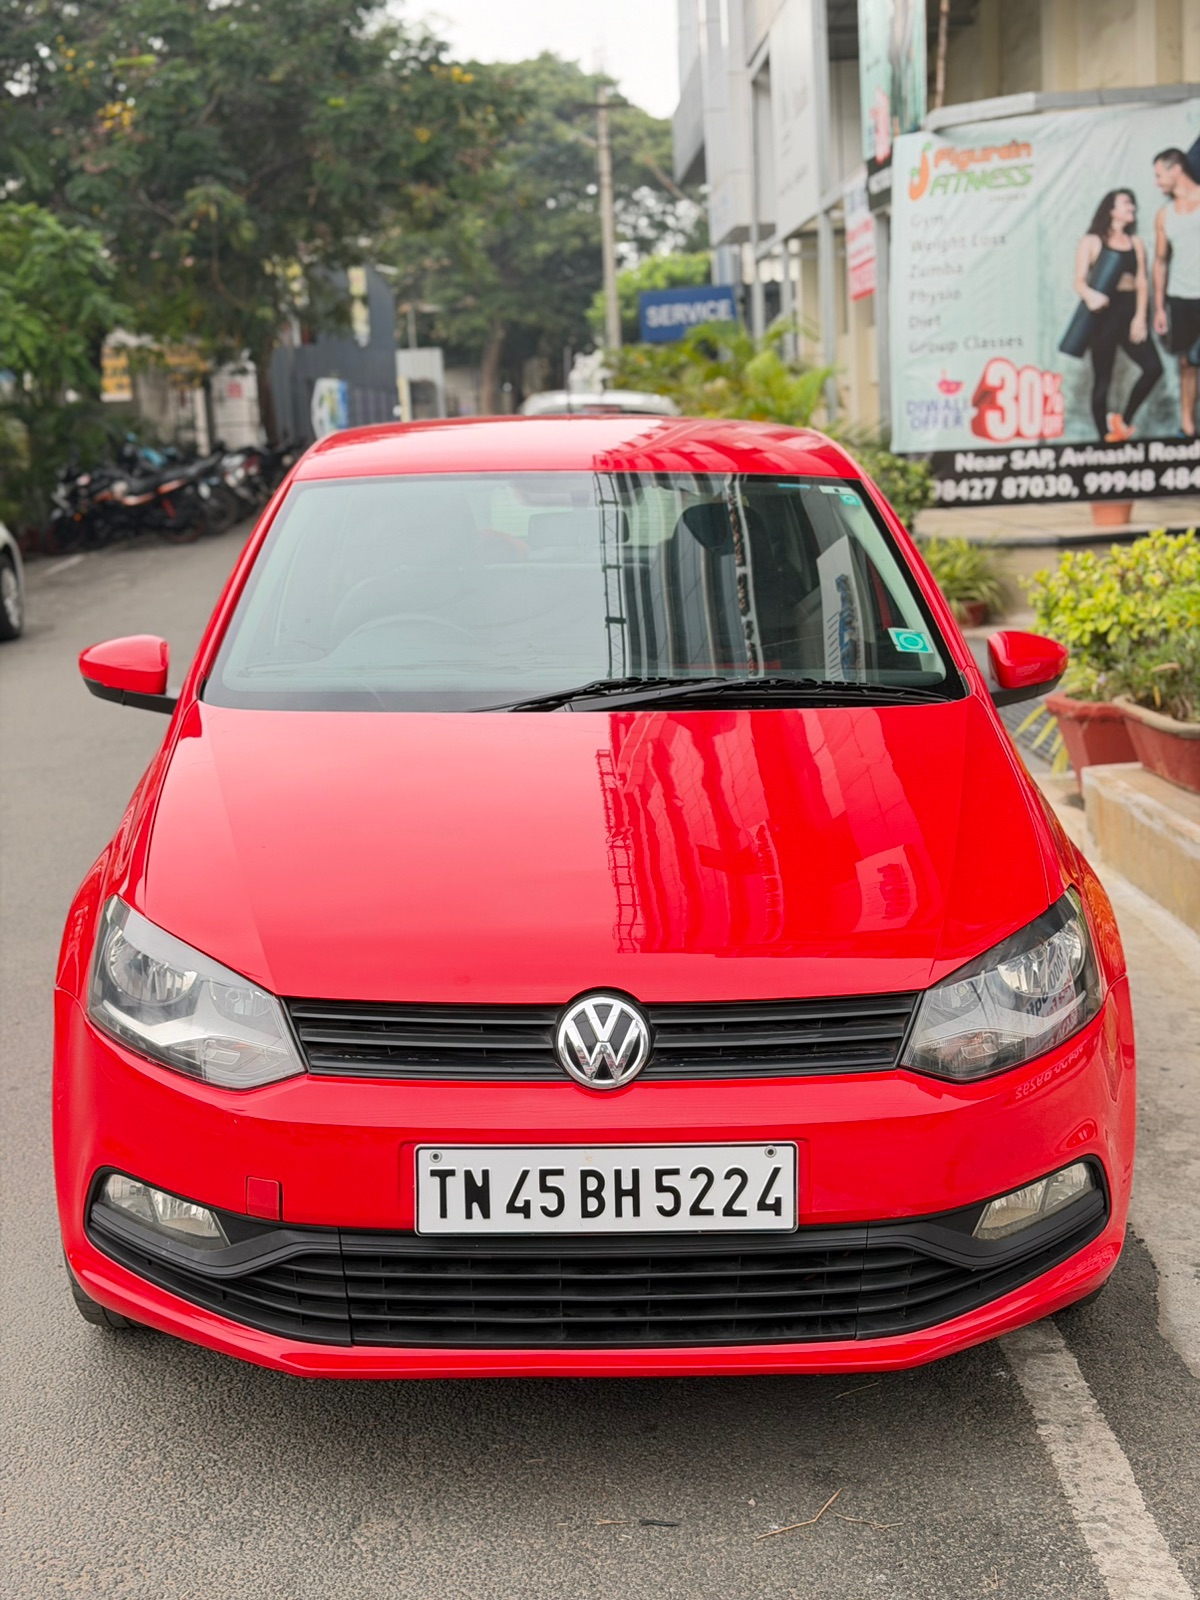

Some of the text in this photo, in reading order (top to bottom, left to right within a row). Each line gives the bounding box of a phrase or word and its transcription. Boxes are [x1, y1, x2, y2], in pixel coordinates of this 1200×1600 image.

[646, 299, 731, 328] SERVICE
[955, 451, 1008, 473] Near
[1059, 444, 1145, 468] Avinashi
[1083, 468, 1156, 494] 99948
[430, 1166, 783, 1220] TN 45 BH 5224
